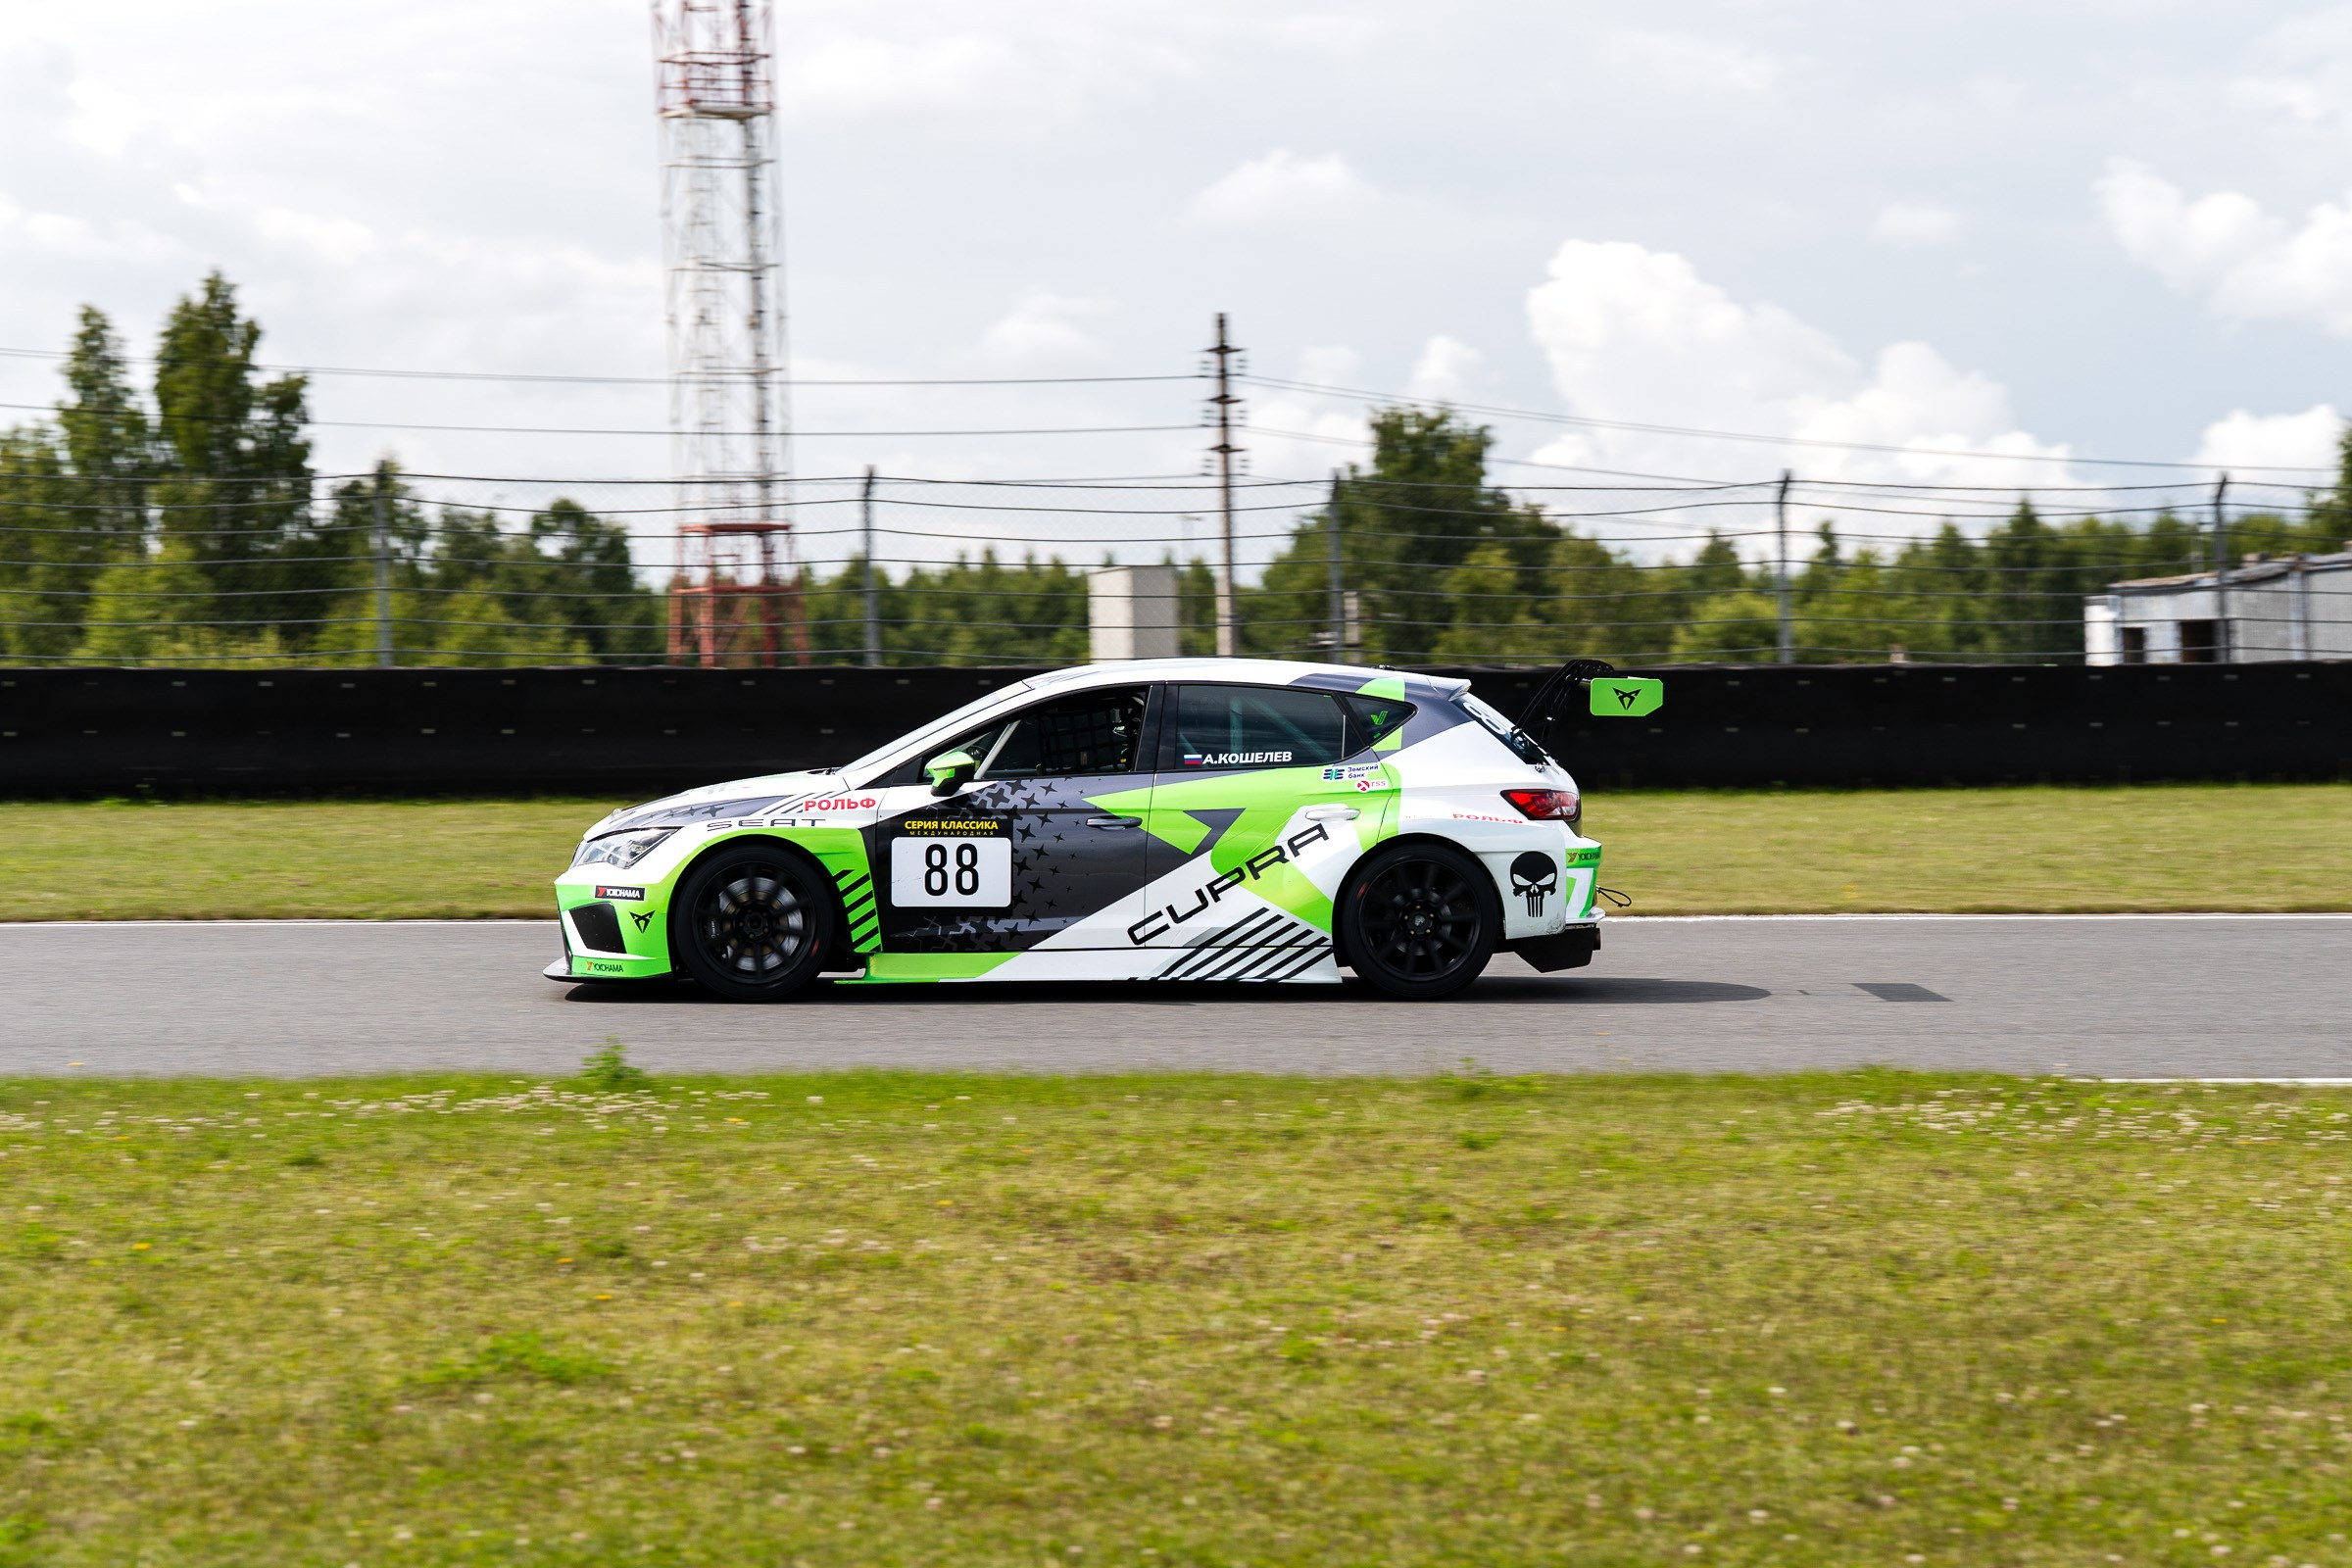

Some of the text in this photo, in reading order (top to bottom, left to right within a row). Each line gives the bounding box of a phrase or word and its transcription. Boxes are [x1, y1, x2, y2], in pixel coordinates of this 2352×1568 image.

[1202, 751, 1293, 764] А.КОШЕЛЕВ
[805, 797, 876, 811] РОЛЬФ
[707, 818, 826, 832] SEAT
[905, 820, 999, 830] СЕРИЯ КЛАССИКА
[924, 843, 979, 896] 88
[1127, 823, 1330, 946] CUPRA
[606, 888, 641, 898] YOKOHAMA
[593, 963, 624, 972] YOKOHAMA
